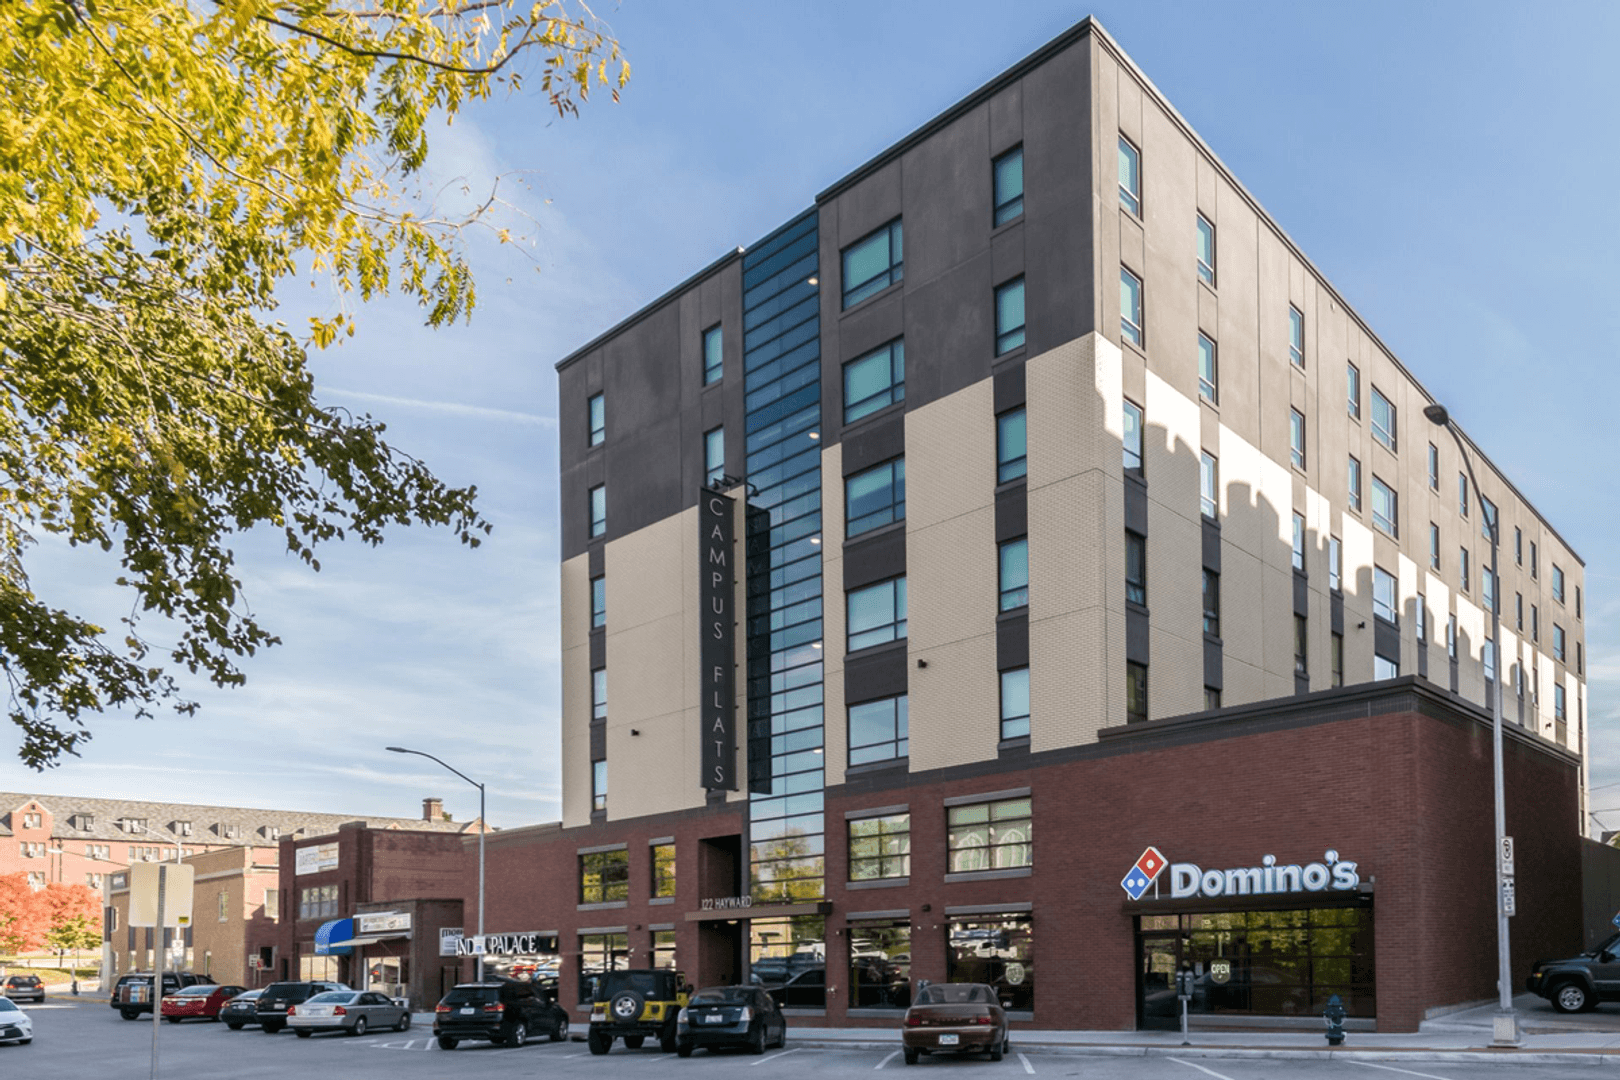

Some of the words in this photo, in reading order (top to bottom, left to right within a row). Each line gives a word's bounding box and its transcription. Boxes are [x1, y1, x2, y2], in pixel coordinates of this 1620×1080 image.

[709, 498, 726, 640] CAMPUS
[712, 666, 726, 783] FLATS
[1170, 849, 1360, 899] Domino's
[715, 895, 752, 909] HAYWARD
[491, 935, 538, 955] PALACE
[1211, 964, 1230, 974] OPEN
